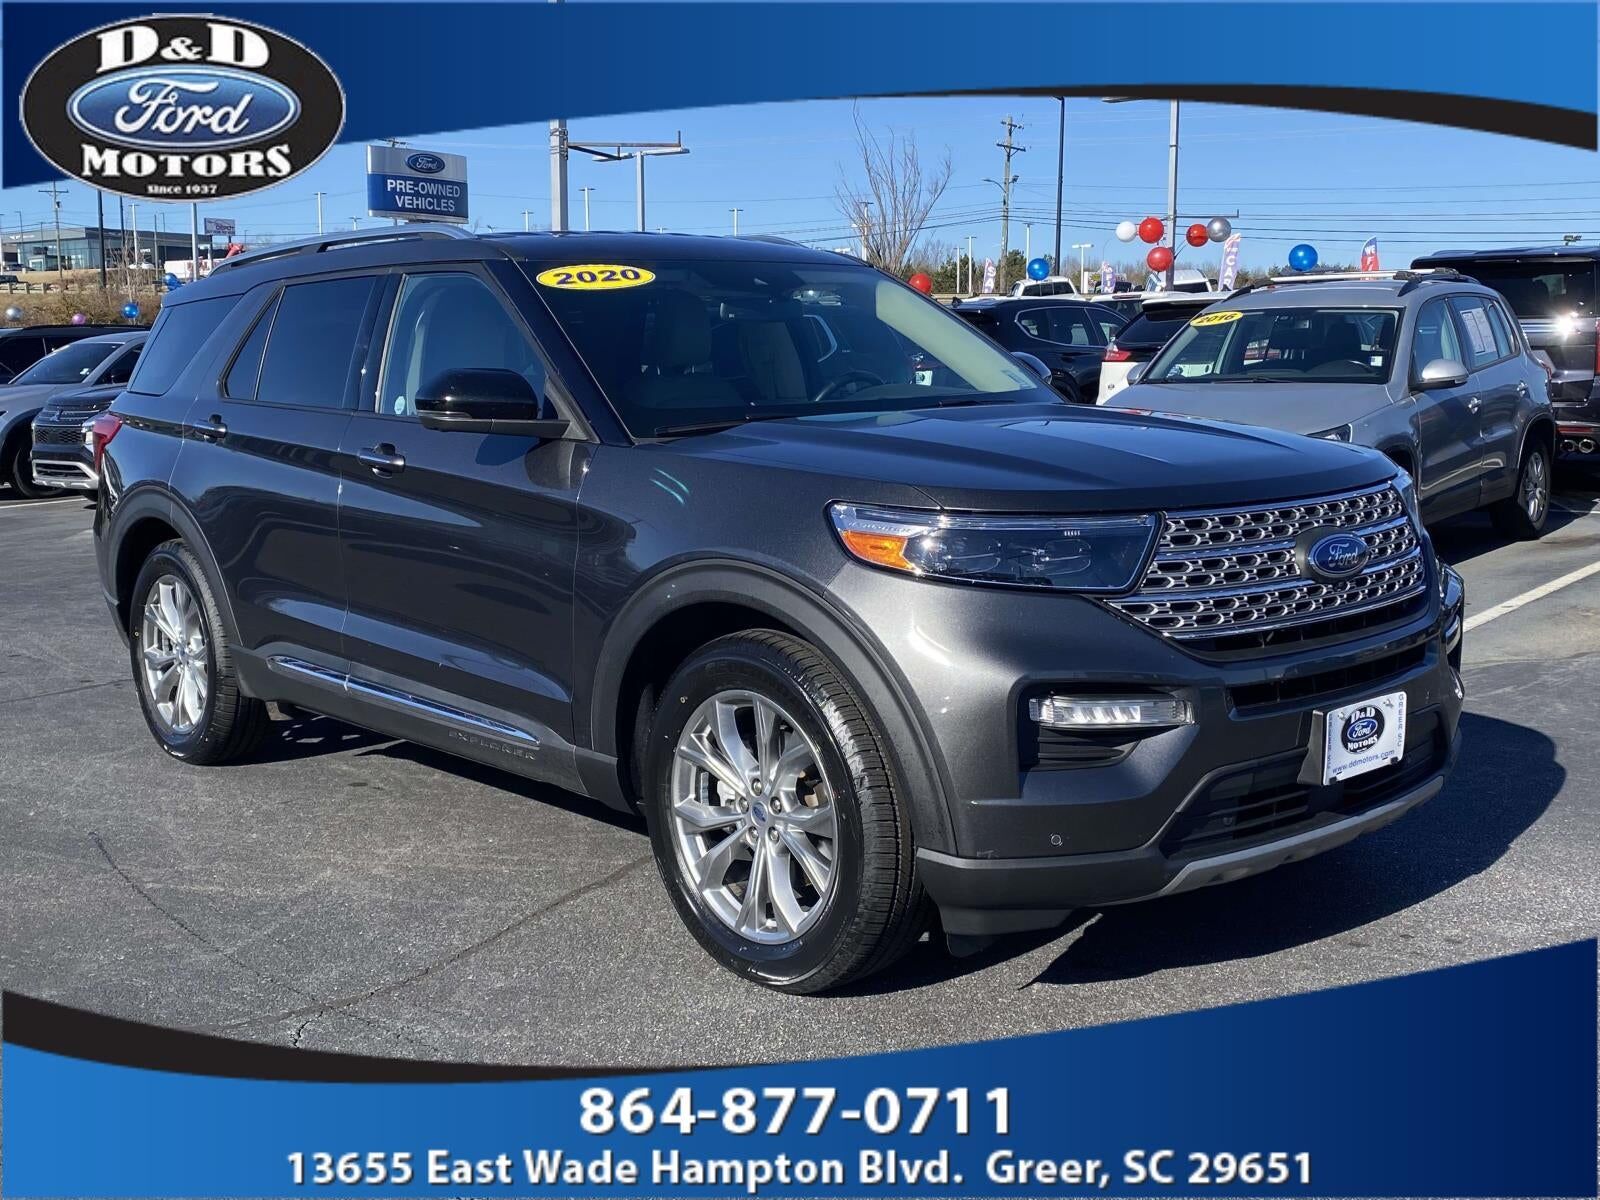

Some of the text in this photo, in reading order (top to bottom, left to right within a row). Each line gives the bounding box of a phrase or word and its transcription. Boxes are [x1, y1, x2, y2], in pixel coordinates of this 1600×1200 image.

[416, 157, 438, 170] Ford
[387, 179, 460, 198] PRE-OWNED
[395, 194, 455, 212] VEHICLES
[553, 268, 641, 285] 2020
[1196, 312, 1238, 324] 2016
[1328, 542, 1359, 568] Ford
[1350, 706, 1376, 724] D&D
[1352, 721, 1373, 738] Ford
[1347, 734, 1378, 752] MOTORS
